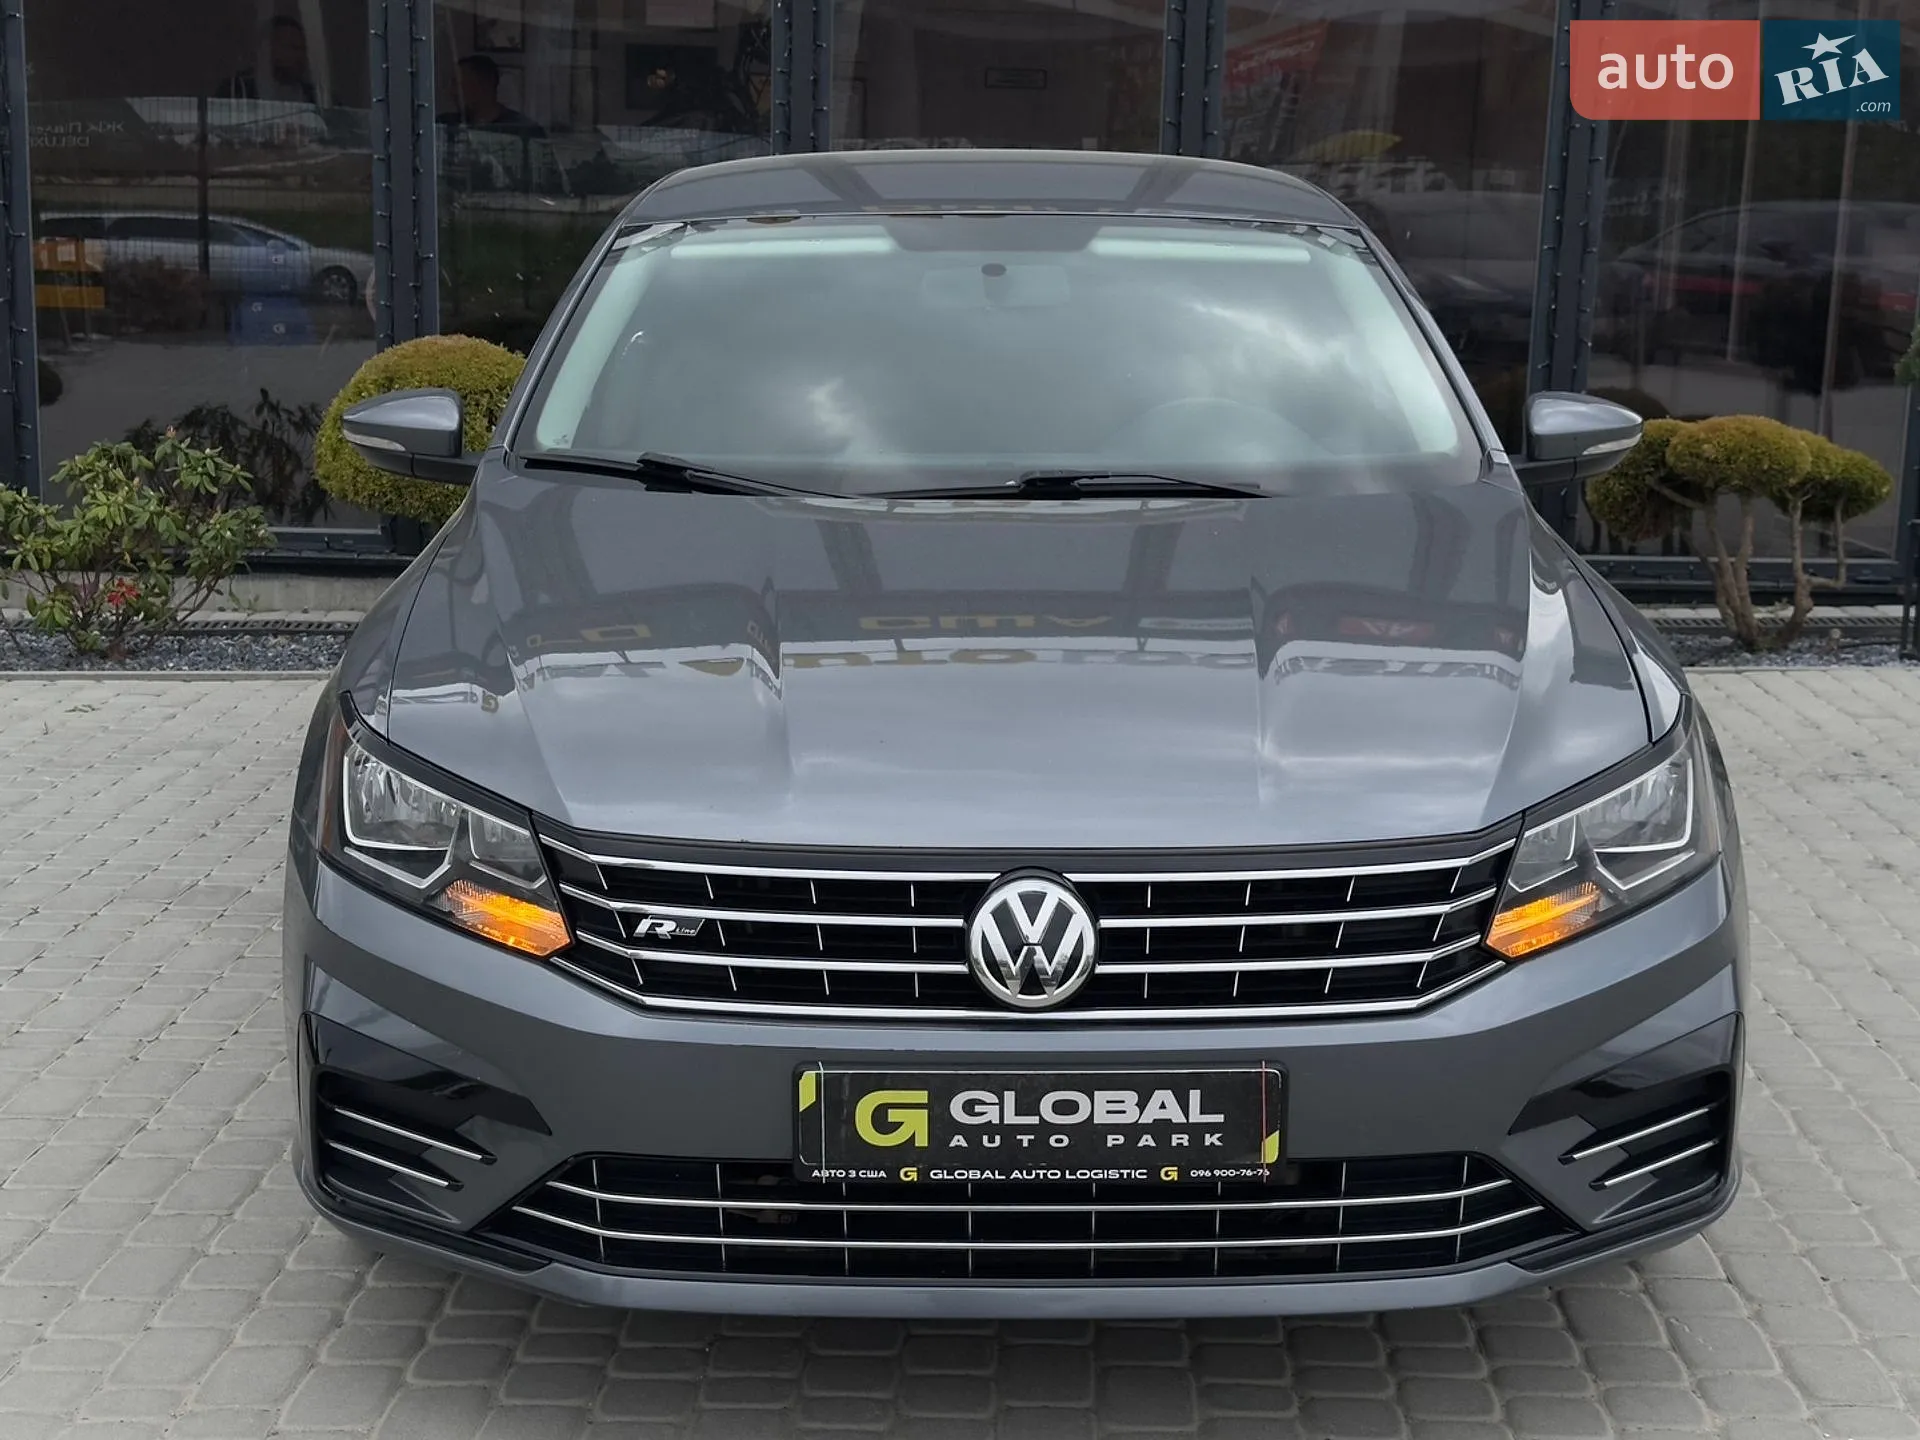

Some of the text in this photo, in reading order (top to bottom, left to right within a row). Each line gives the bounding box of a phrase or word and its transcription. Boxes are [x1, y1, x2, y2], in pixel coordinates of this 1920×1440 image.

[633, 917, 677, 940] R
[949, 1089, 1225, 1125] GLOBAL
[949, 1132, 1224, 1148] AUTO PARK
[858, 1169, 888, 1179] США
[929, 1169, 1006, 1180] GLOBAL
[1010, 1169, 1061, 1180] AUTO
[1065, 1168, 1148, 1180] LOGISTIC
[1190, 1169, 1212, 1178] 096
